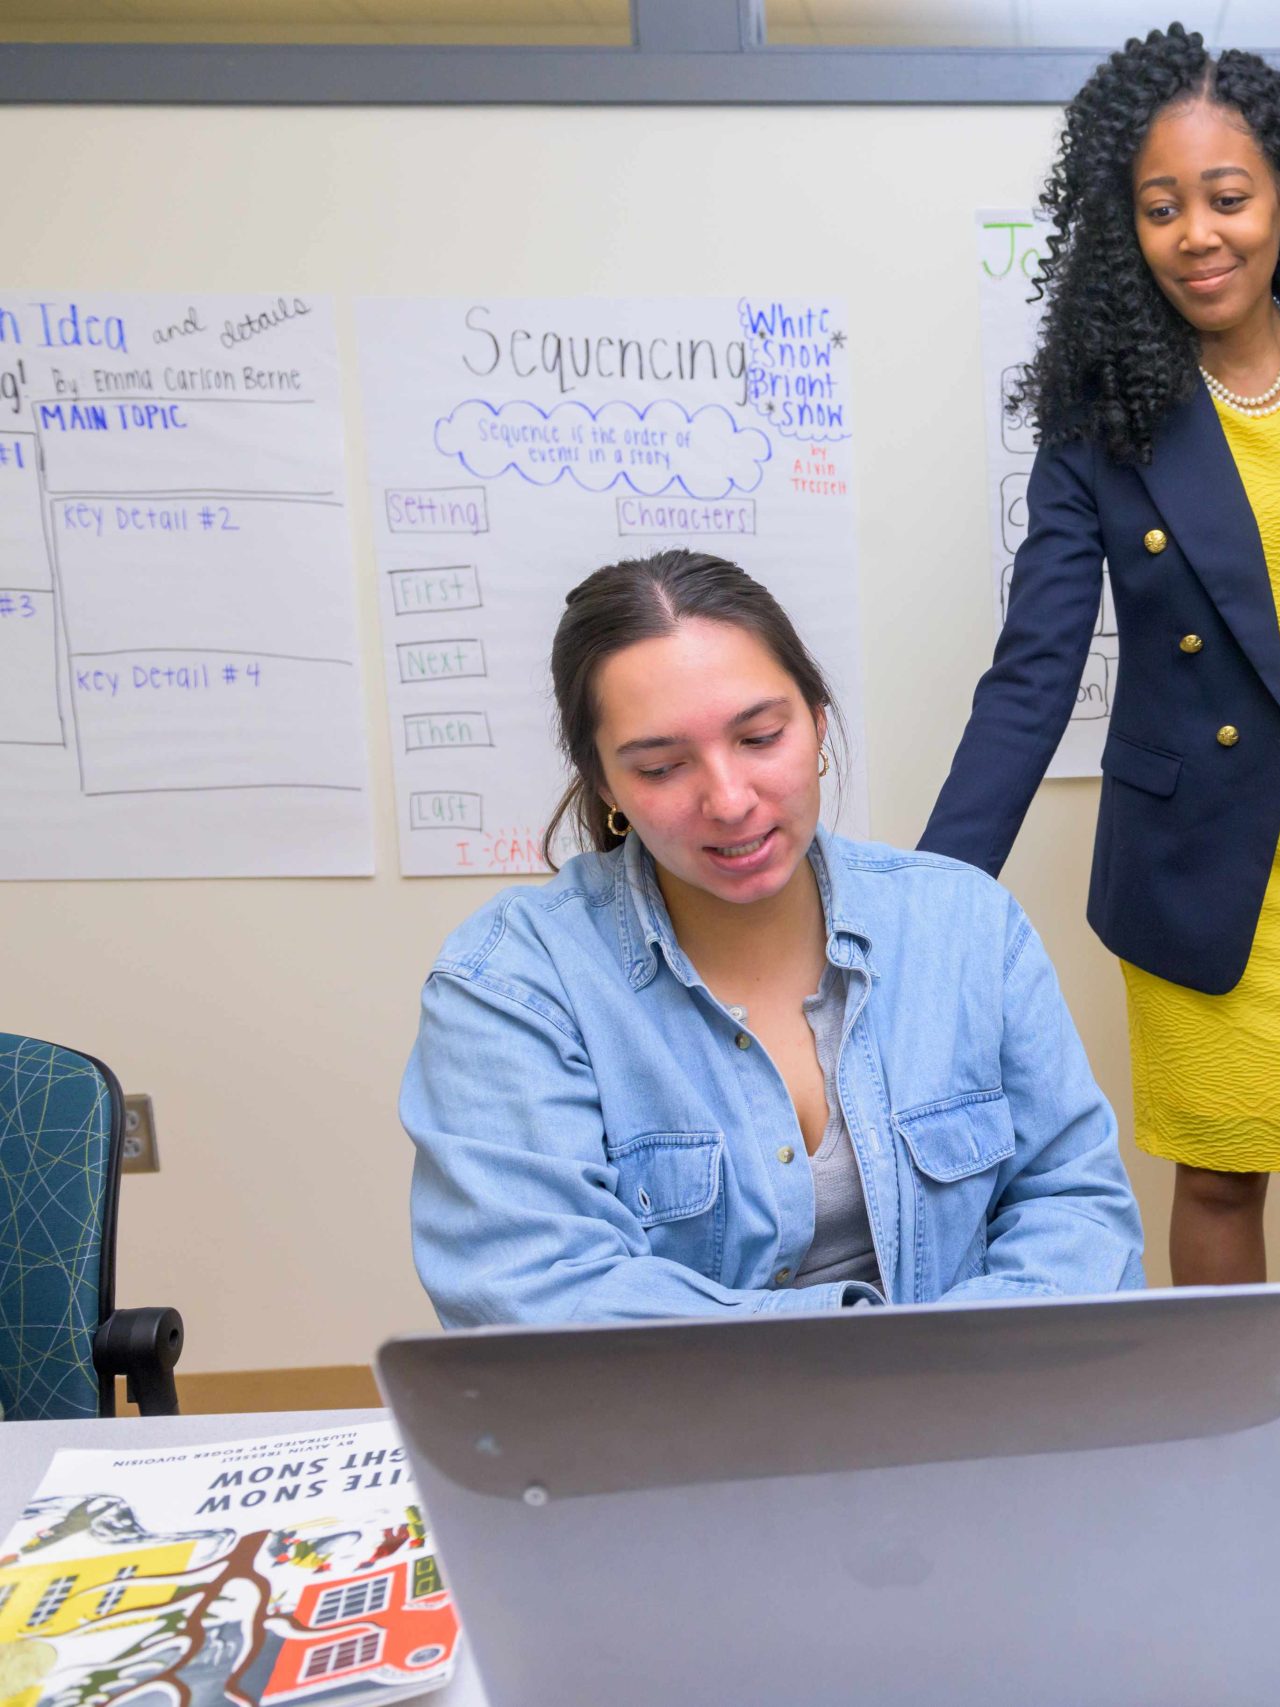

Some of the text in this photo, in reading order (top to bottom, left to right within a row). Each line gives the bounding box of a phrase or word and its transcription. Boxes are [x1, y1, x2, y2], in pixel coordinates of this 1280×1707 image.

[153, 306, 206, 345] and
[219, 297, 312, 349] details
[462, 305, 748, 407] Sequencing
[243, 366, 302, 391] Berne
[40, 404, 188, 431] MAIN TOPIC
[591, 425, 617, 445] the
[624, 427, 668, 447] order
[675, 430, 693, 449] of
[389, 492, 480, 535] Setting
[622, 501, 748, 532] Characters
[400, 574, 466, 607] First
[406, 645, 471, 677] Next
[407, 718, 473, 746] Then
[416, 796, 467, 822] Last
[112, 1455, 187, 1468] DUVOISIN
[194, 1448, 245, 1460] ROGER
[289, 1443, 331, 1455] ALVIN
[208, 1446, 408, 1490] GHT SNOW
[195, 1468, 414, 1515] ITE SNOW
